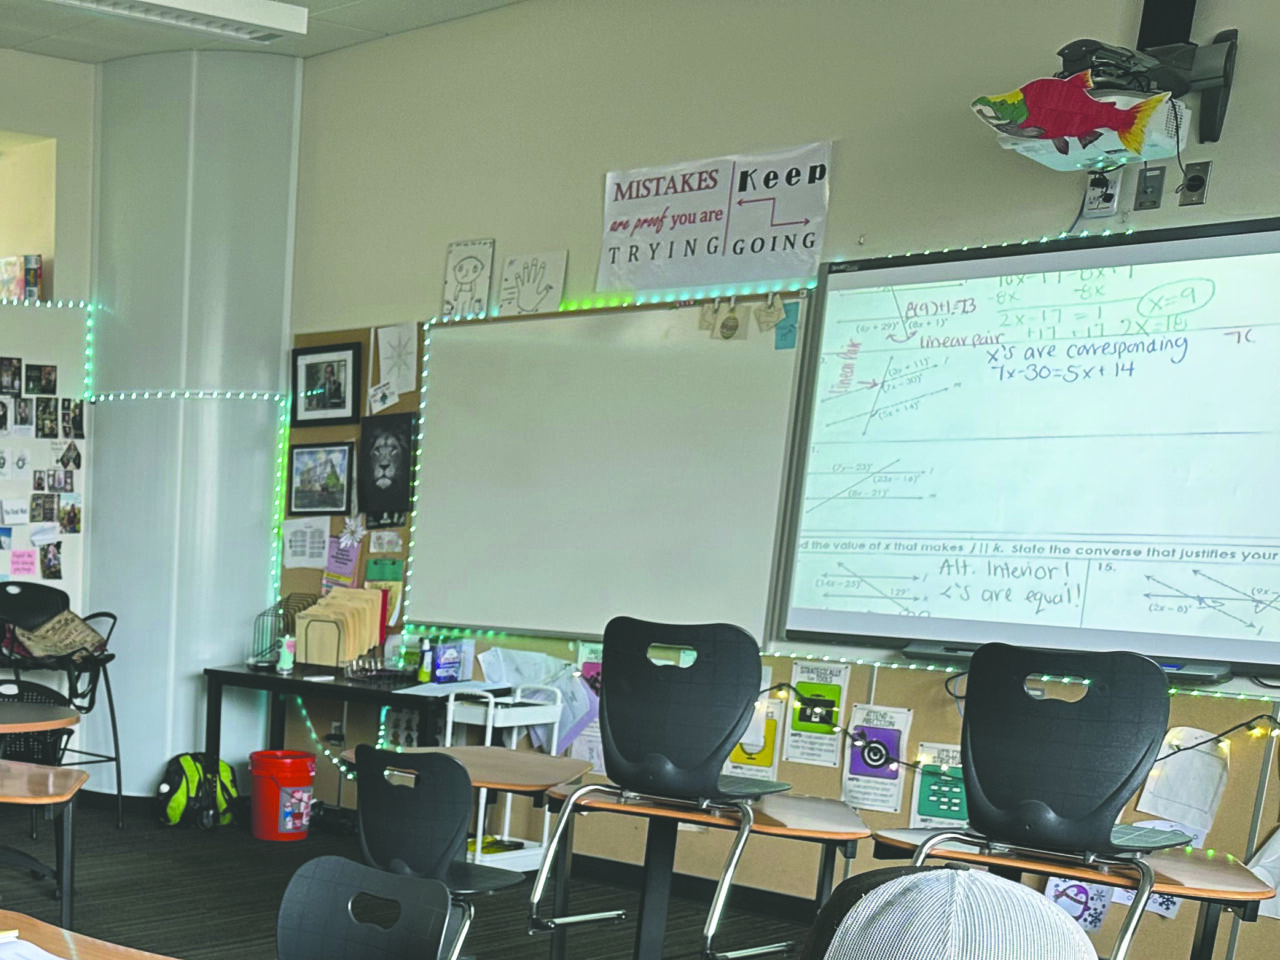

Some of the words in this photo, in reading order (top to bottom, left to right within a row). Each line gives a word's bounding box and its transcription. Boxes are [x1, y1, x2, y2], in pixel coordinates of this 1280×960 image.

[613, 169, 719, 201] MISTAKES
[738, 163, 827, 192] Keep
[610, 219, 629, 232] are
[629, 206, 670, 237] proof
[670, 211, 696, 231] you
[699, 209, 723, 223] are
[609, 236, 719, 264] TRYING
[732, 232, 816, 256] GOING
[1024, 343, 1056, 360] are
[1066, 337, 1189, 364] corresponding
[811, 541, 829, 550] the
[833, 541, 866, 550] value
[869, 541, 881, 551] of
[894, 542, 917, 551] that
[921, 542, 963, 552] makes
[1011, 544, 1045, 554] State
[1049, 544, 1070, 555] the
[1075, 546, 1141, 556] converse
[1146, 547, 1176, 557] that
[1178, 548, 1236, 559] justifies
[1242, 550, 1278, 561] your
[981, 587, 1013, 602] are
